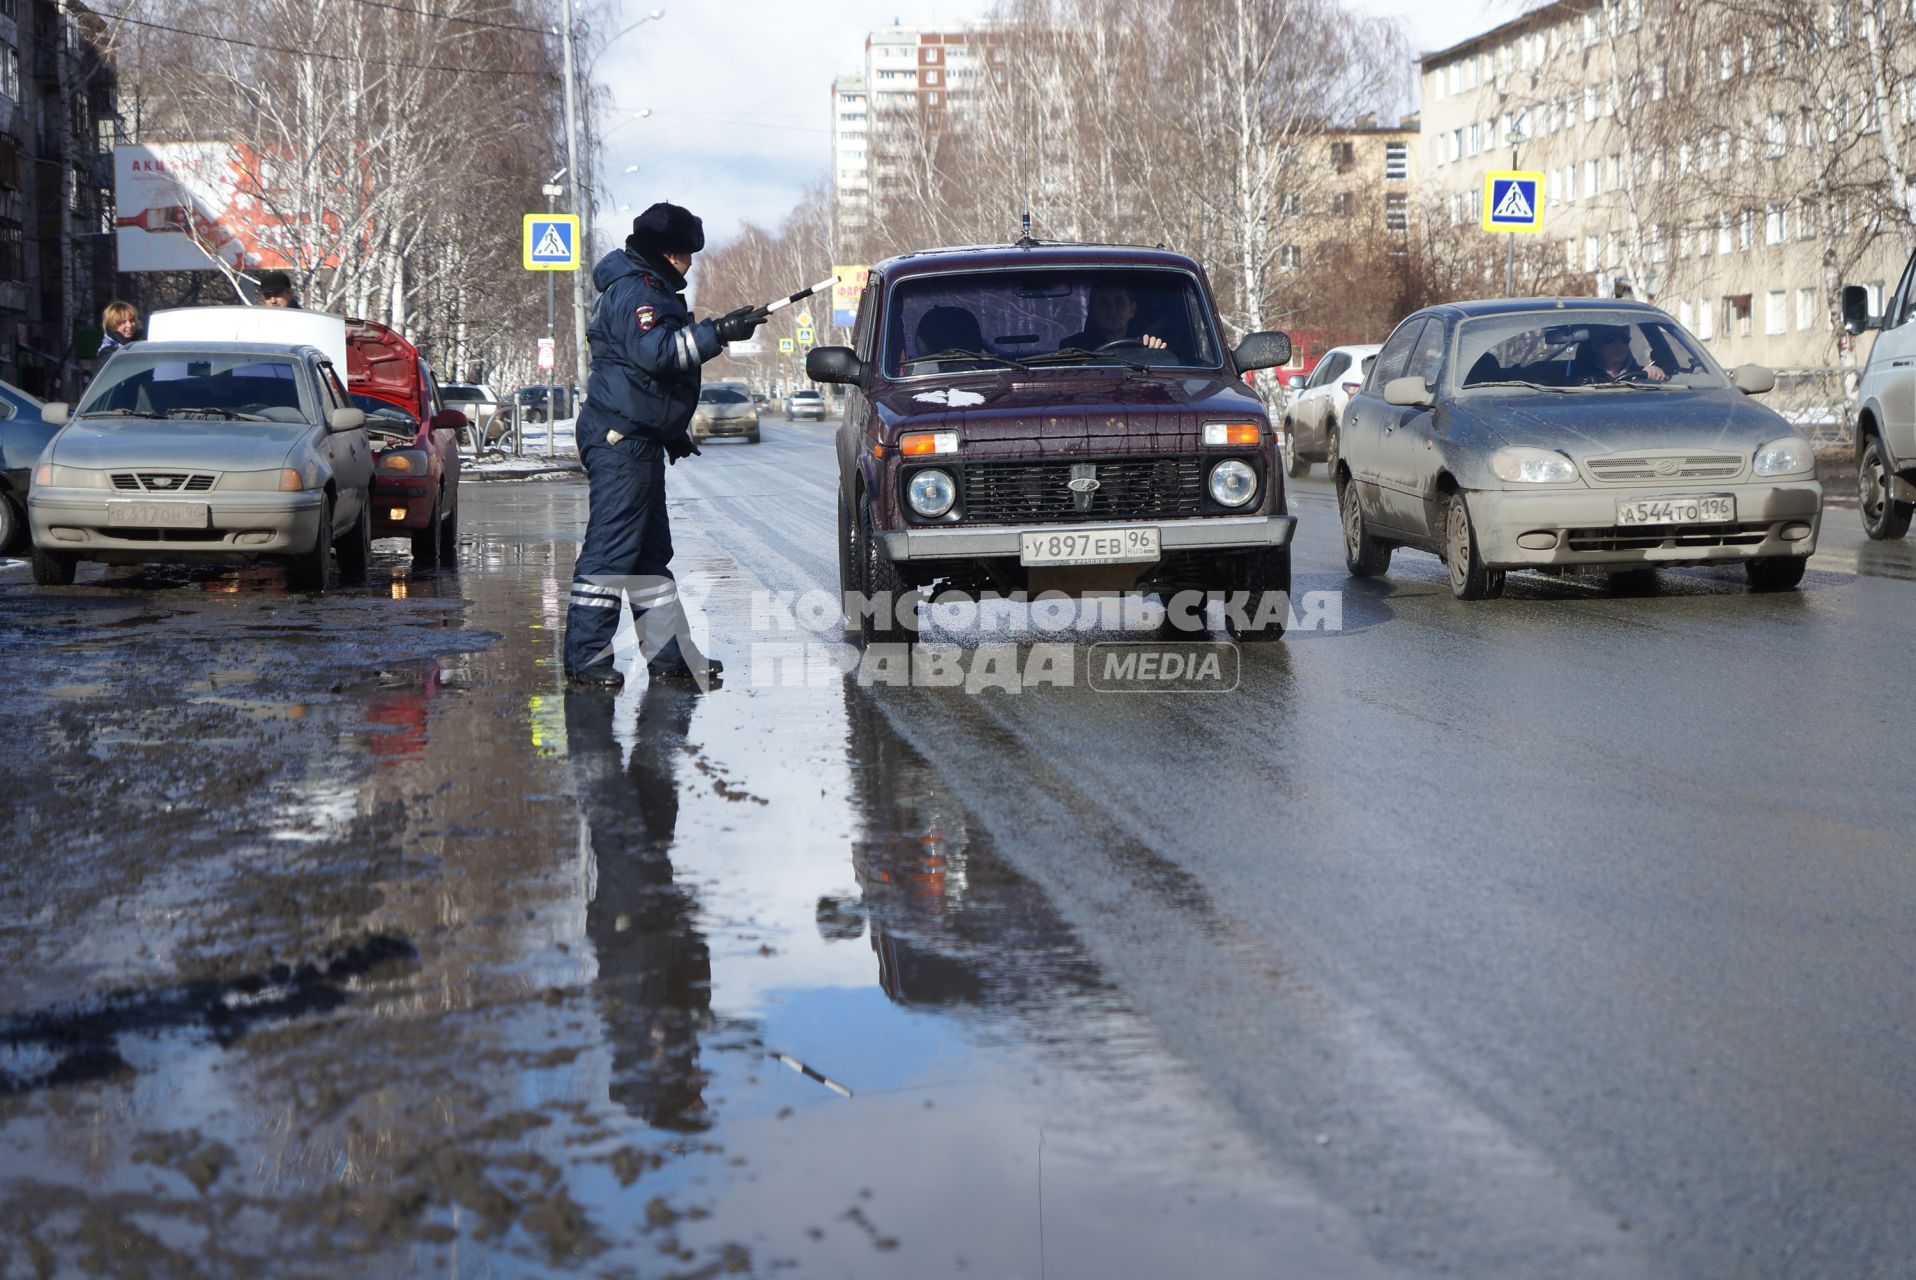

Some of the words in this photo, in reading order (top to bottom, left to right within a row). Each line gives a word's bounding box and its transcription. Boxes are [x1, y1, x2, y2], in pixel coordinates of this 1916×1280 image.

[1625, 503, 1698, 522] А544ТО
[1702, 500, 1729, 514] 196
[1033, 535, 1122, 557] У897ЕВ
[1128, 531, 1150, 547] 96
